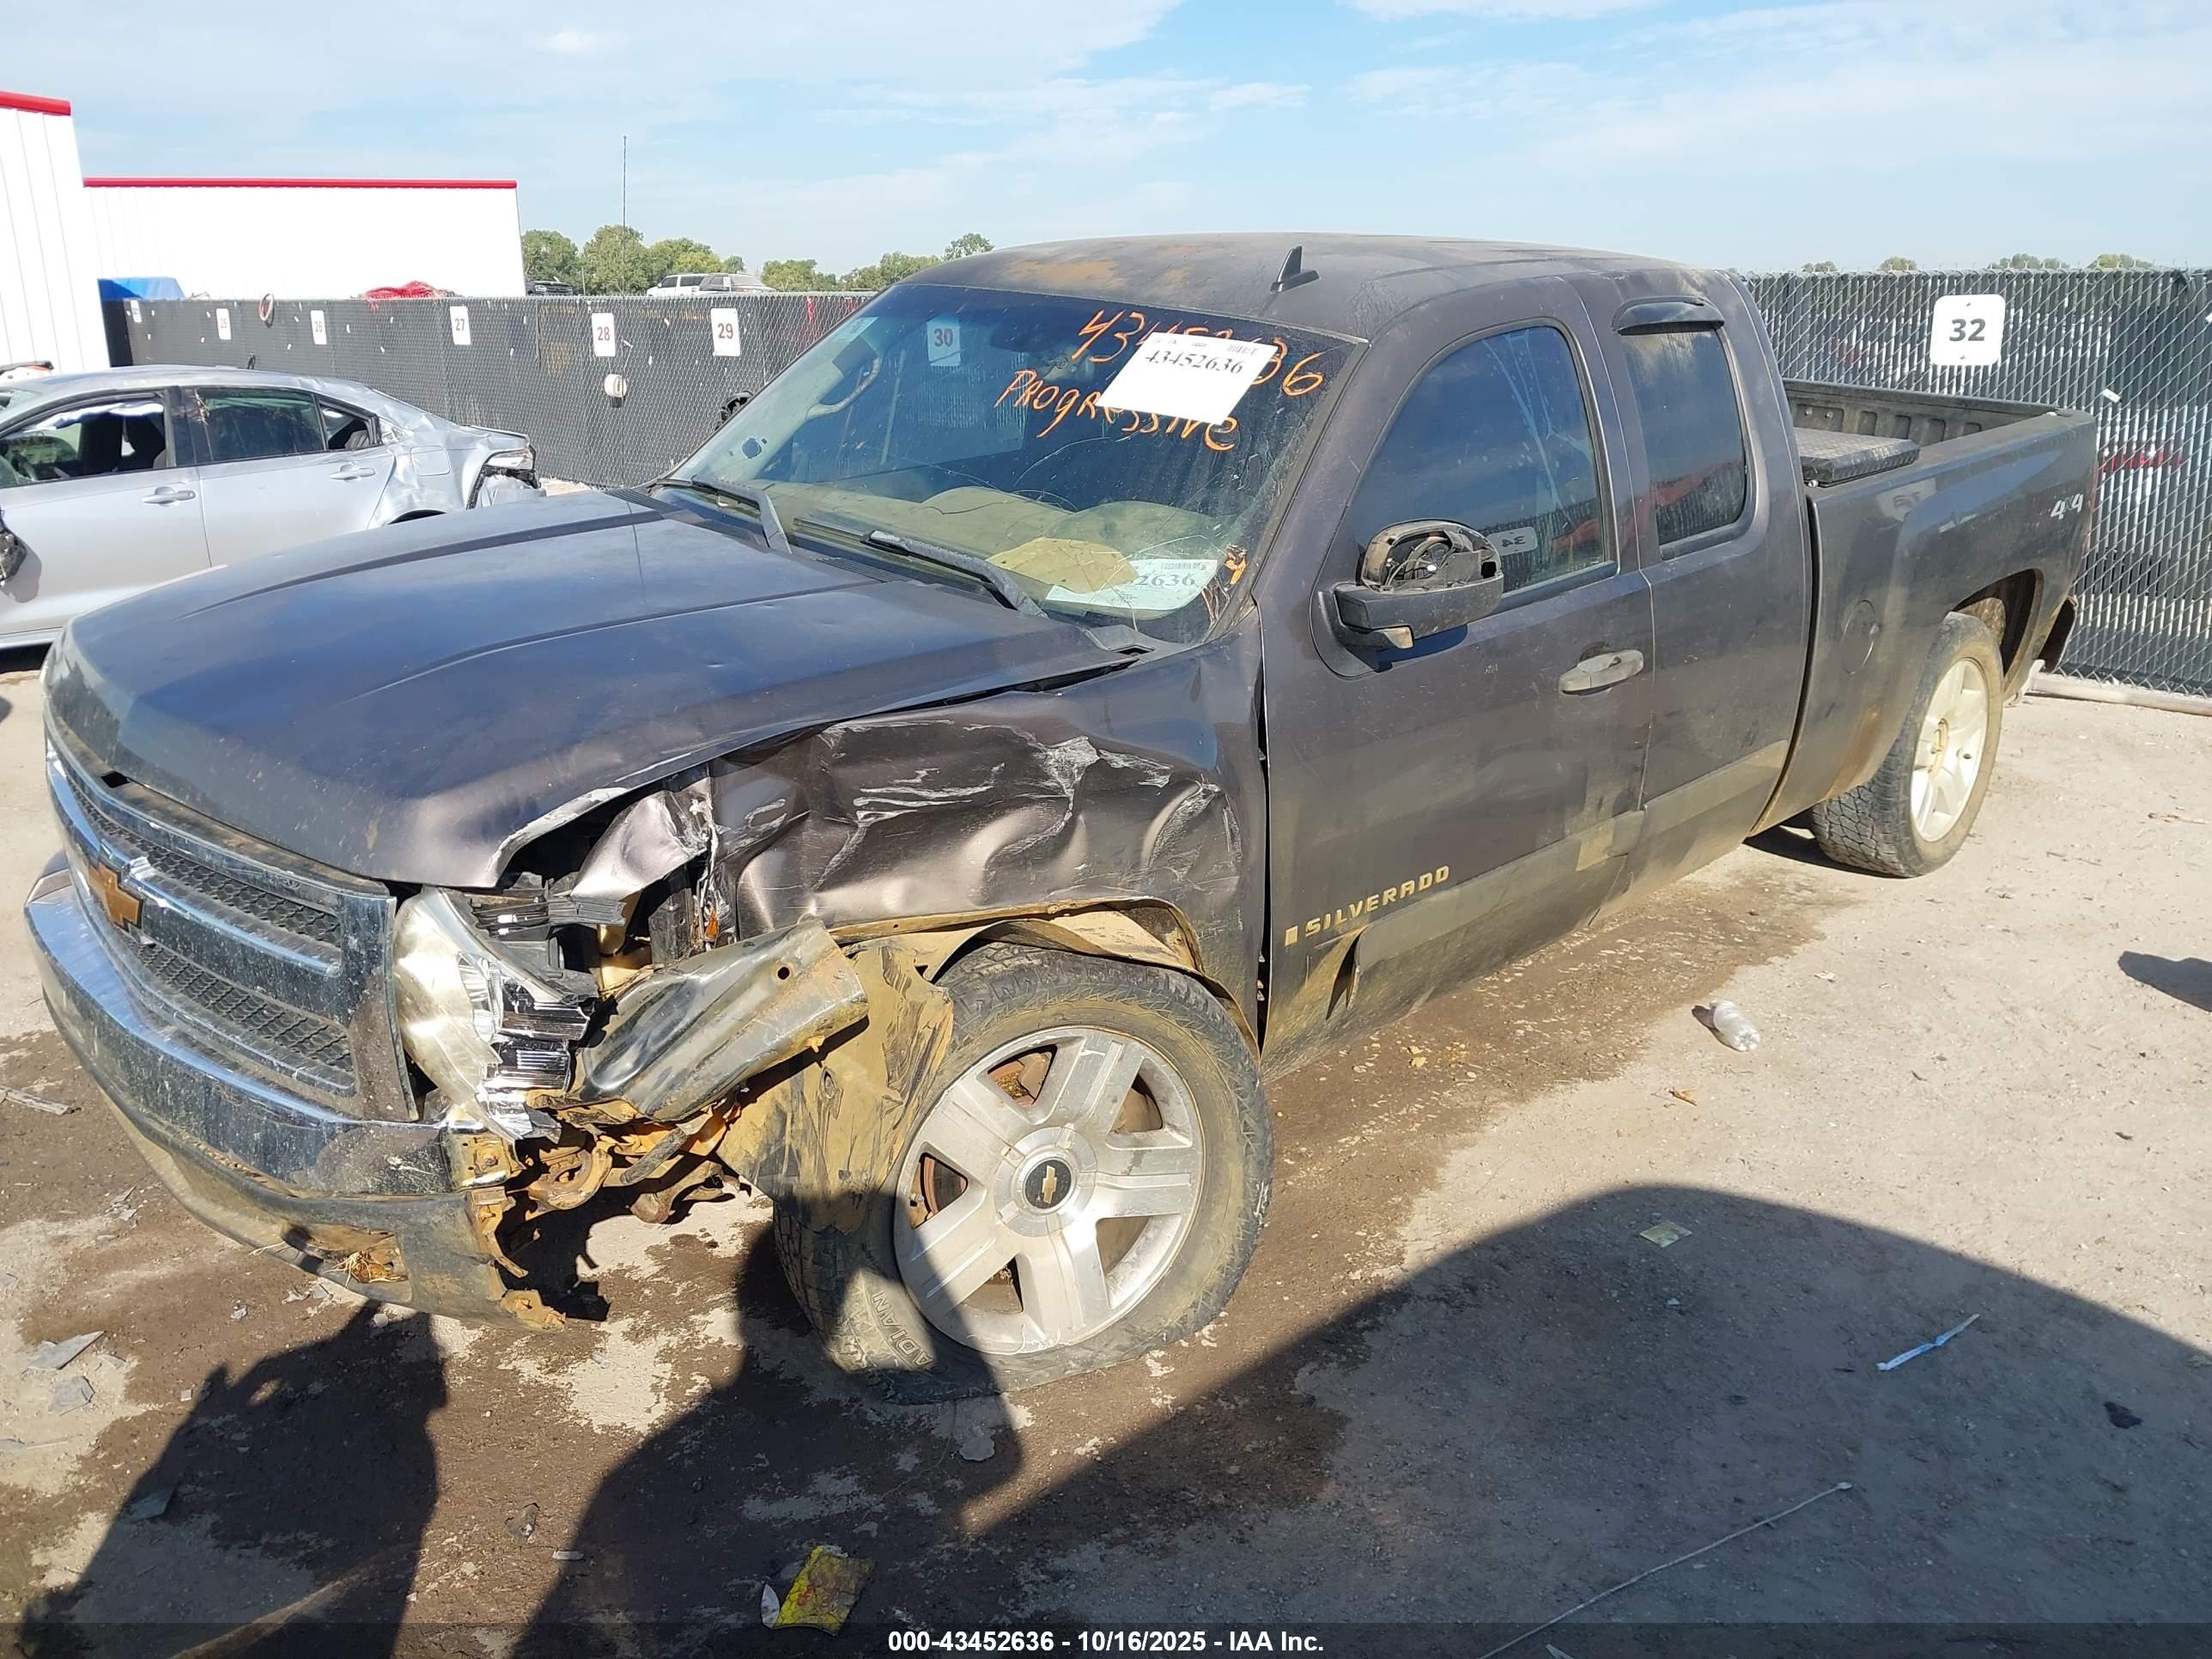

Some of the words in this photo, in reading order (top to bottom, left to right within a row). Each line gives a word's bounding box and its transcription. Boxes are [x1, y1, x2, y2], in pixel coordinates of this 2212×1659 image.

[314, 320, 323, 332] 26
[454, 319, 465, 331] 27
[717, 323, 734, 339] 29
[1948, 319, 1986, 342] 32
[597, 326, 611, 341] 28
[933, 327, 953, 348] 30
[1145, 349, 1243, 374] 43452636
[1133, 574, 1195, 586] 2636
[1304, 865, 1449, 938] SILVERADO
